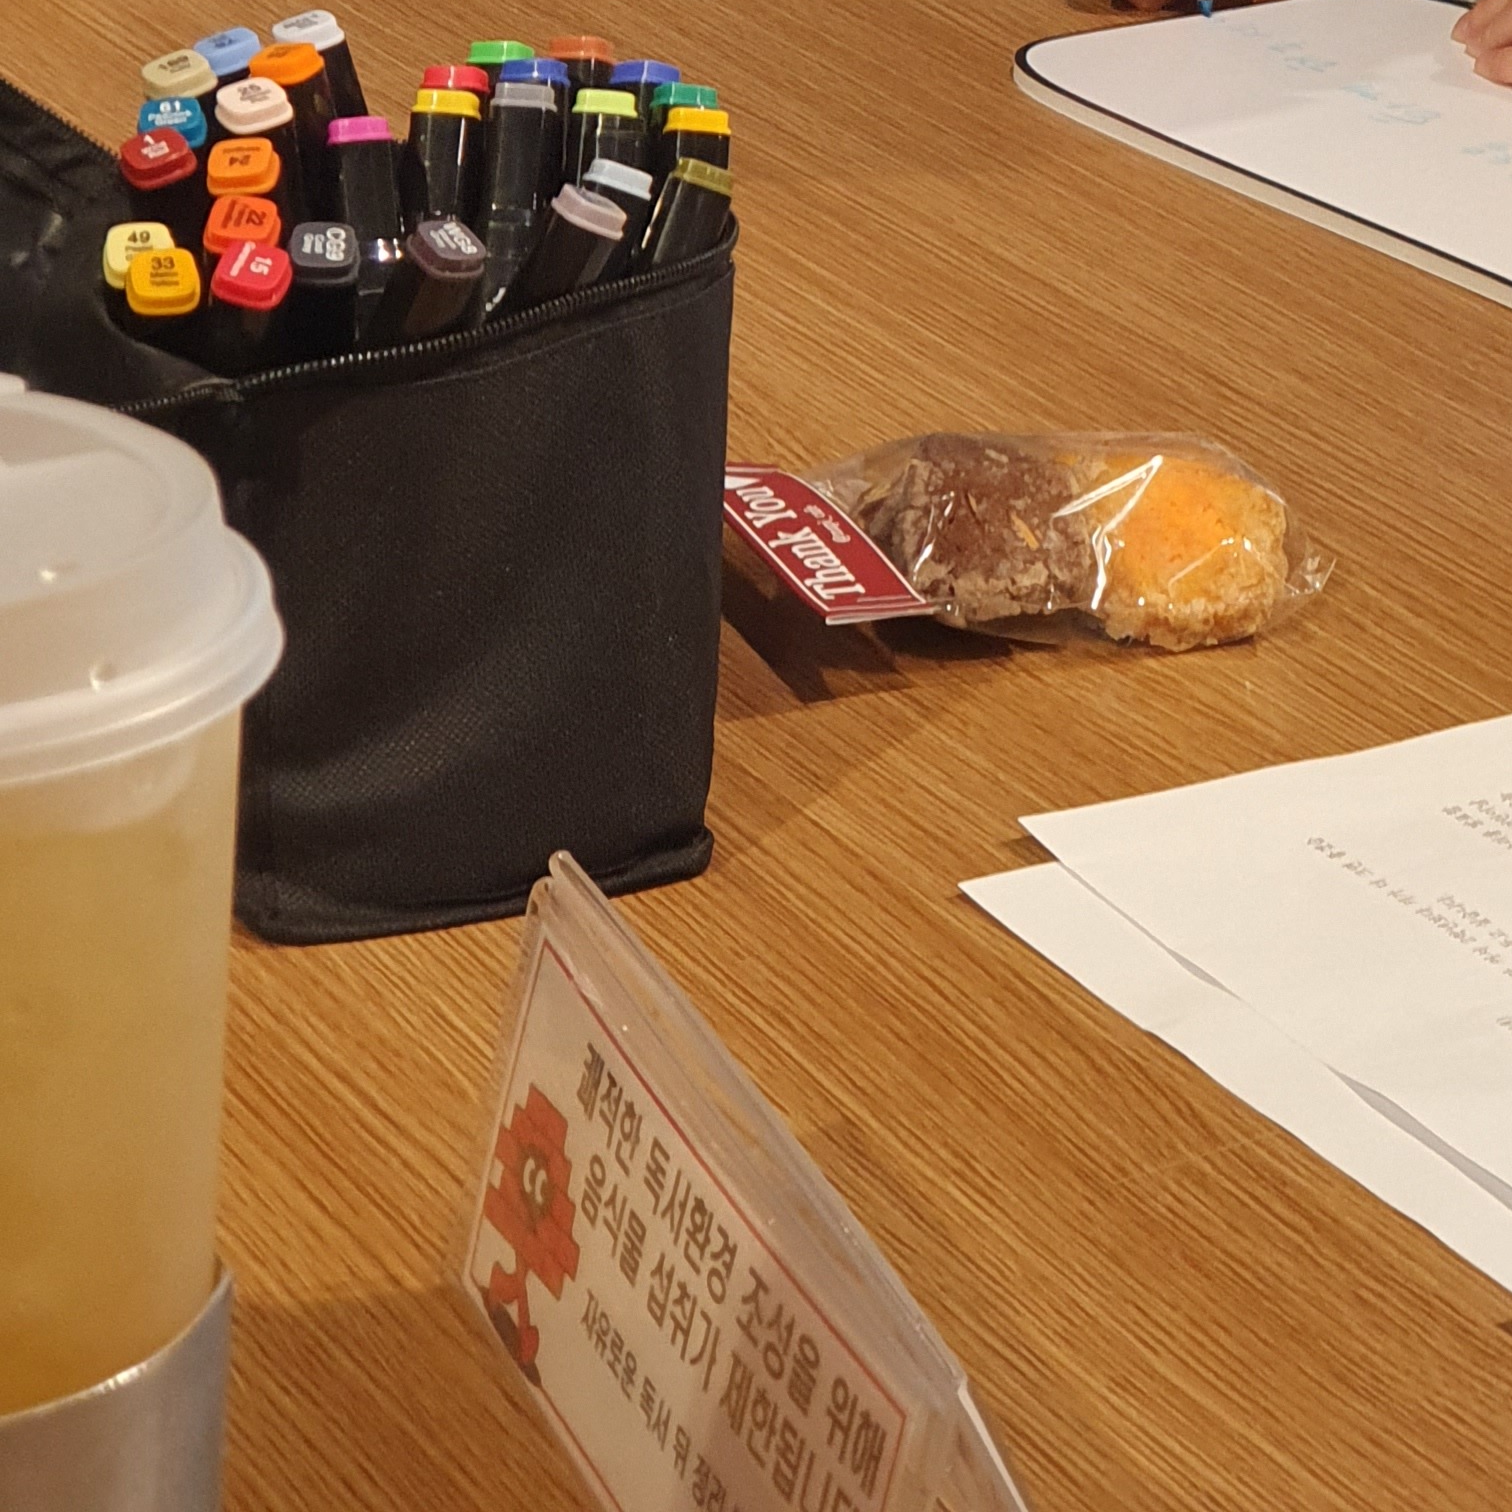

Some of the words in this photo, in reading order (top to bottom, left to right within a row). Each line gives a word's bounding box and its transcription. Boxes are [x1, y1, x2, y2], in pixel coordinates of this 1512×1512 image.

[127, 230, 151, 244] 49
[151, 255, 176, 270] 33
[249, 255, 273, 276] 15
[735, 485, 798, 529] You
[768, 525, 866, 601] Thank
[576, 1041, 643, 1178] 쾌적한
[643, 1136, 738, 1305] 독서환경
[735, 1265, 821, 1419] 조성을
[826, 1375, 888, 1500] 위해
[580, 1153, 647, 1288] 음식물
[646, 1251, 721, 1393] 섭취가
[580, 1287, 638, 1402] 자유로운
[639, 1374, 672, 1453] 독서
